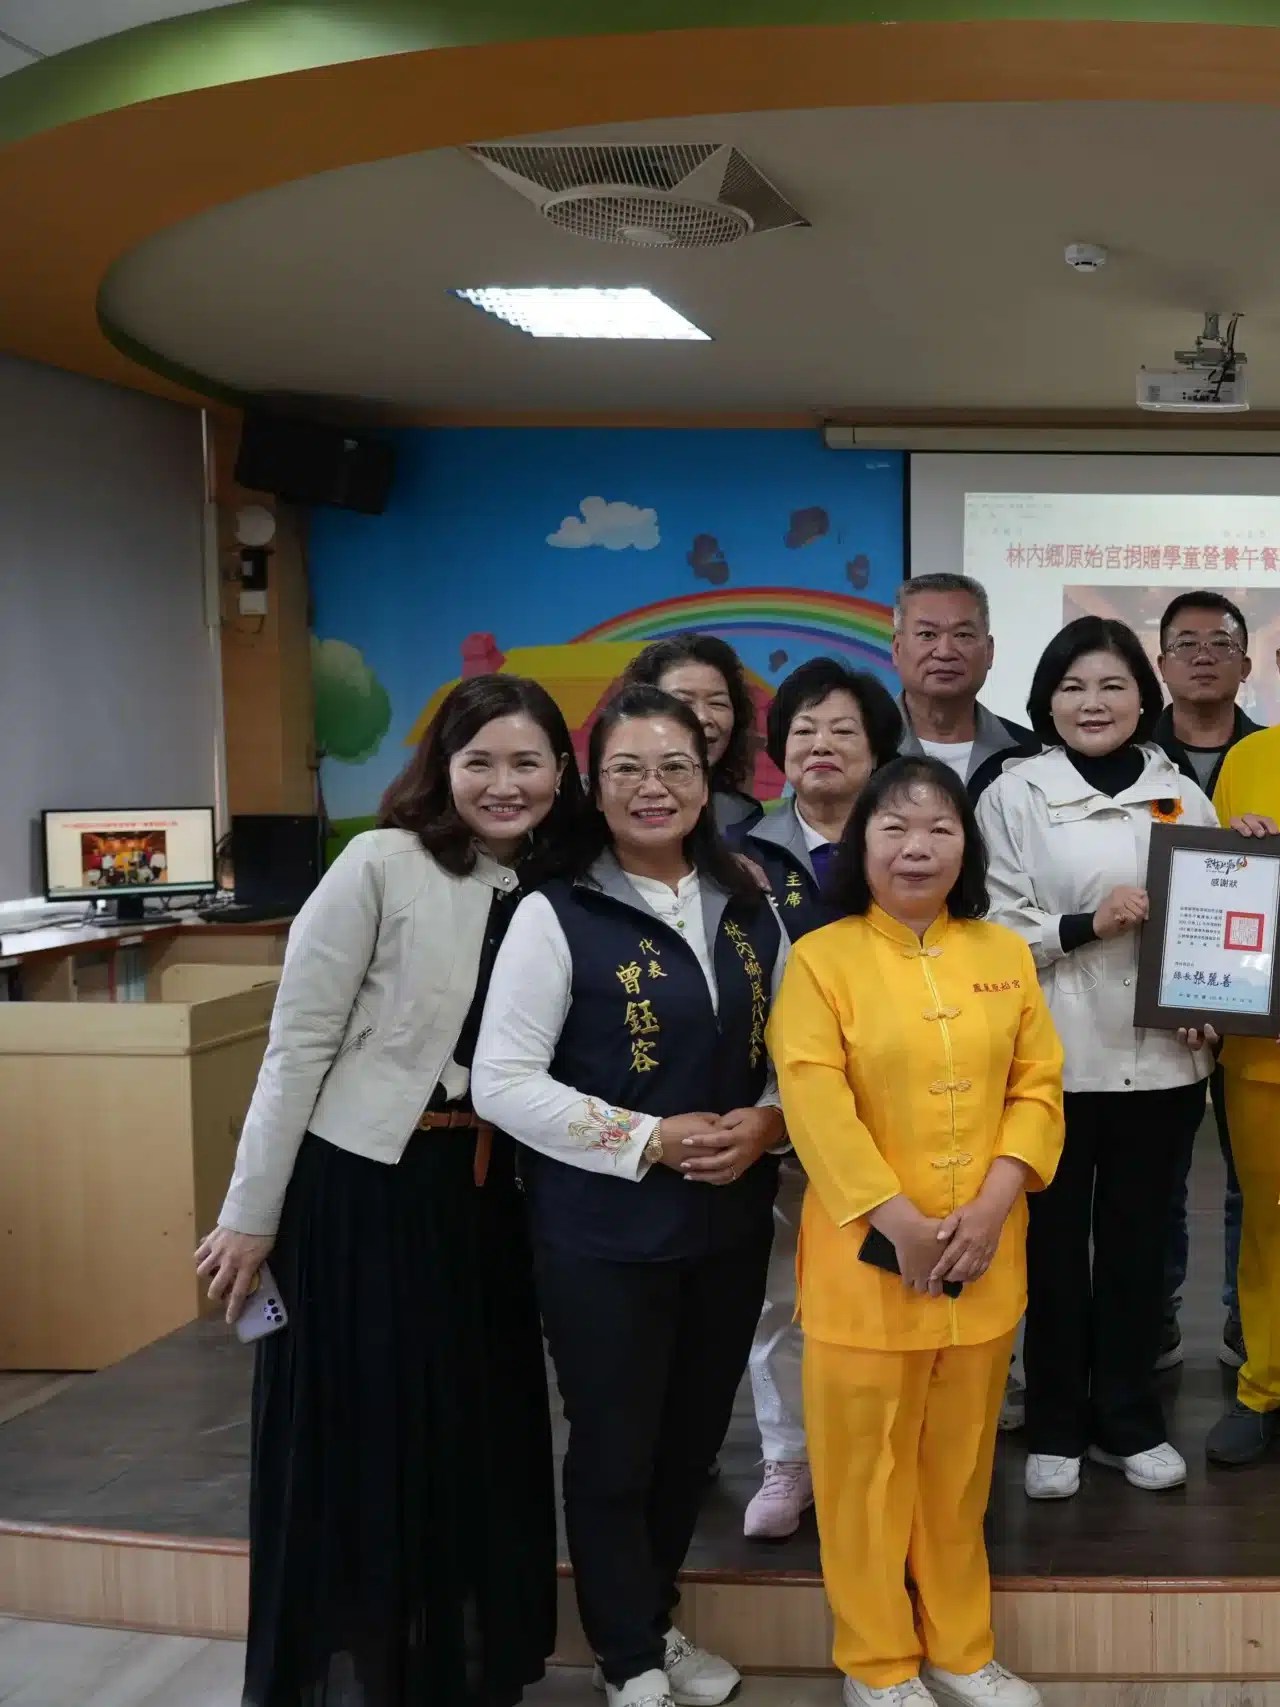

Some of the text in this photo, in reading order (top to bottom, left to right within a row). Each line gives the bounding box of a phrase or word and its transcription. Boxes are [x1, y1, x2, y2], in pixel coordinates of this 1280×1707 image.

[784, 871, 802, 908] 主席
[1210, 877, 1238, 888] 感謝狀
[638, 937, 668, 979] 代表
